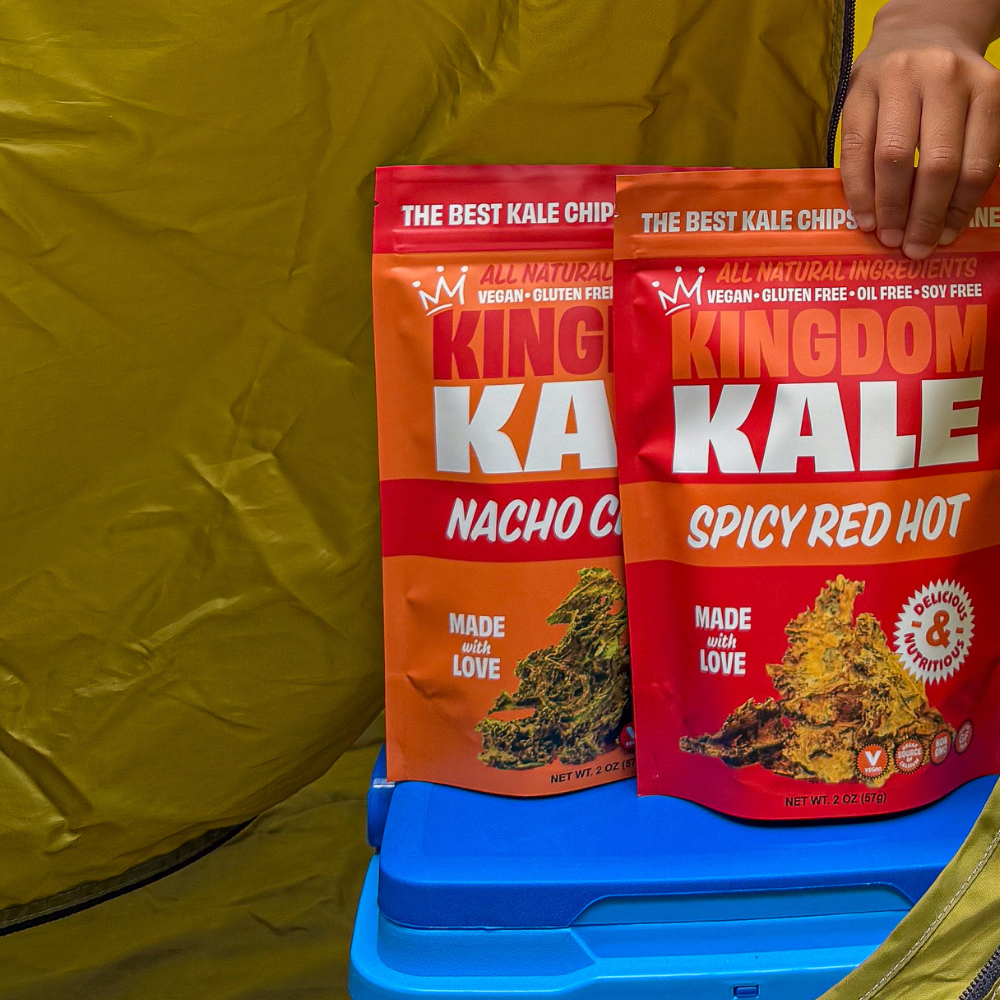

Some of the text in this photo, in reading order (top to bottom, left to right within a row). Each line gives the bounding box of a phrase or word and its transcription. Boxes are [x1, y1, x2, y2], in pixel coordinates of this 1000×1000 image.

[402, 204, 443, 226] THE
[448, 203, 503, 225] BEST
[507, 202, 560, 224] KALE
[641, 208, 858, 233] THE BEST KALE CHIPS
[480, 261, 612, 285] ALL NATURAL
[716, 257, 978, 284] ALL NATURAL INGREDIENTS
[477, 288, 523, 304] VEGAN
[532, 287, 582, 302] GLUTEN
[706, 283, 982, 304] VEGAN GLUTEN FREE OIL FREE SOY FREE
[433, 305, 614, 380] KING
[672, 304, 988, 380] KINGDOM
[433, 380, 618, 474] KA
[672, 376, 983, 474] KALE
[446, 496, 584, 543] NACHO
[687, 492, 971, 550] SPICY RED HOT
[695, 604, 752, 631] MADE
[913, 590, 968, 622] DELICIOUS
[449, 612, 506, 638] MADE
[461, 638, 491, 655] with
[706, 631, 737, 649] with
[903, 632, 965, 672] NUTRITIOUS
[452, 653, 501, 680] LOVE
[699, 648, 747, 676] LOVE
[550, 772, 573, 783] NET
[575, 767, 593, 779] WT.
[596, 766, 602, 775] 2
[605, 762, 619, 772] OZ
[785, 791, 887, 807] NET WT. 2 OZ (57g)
